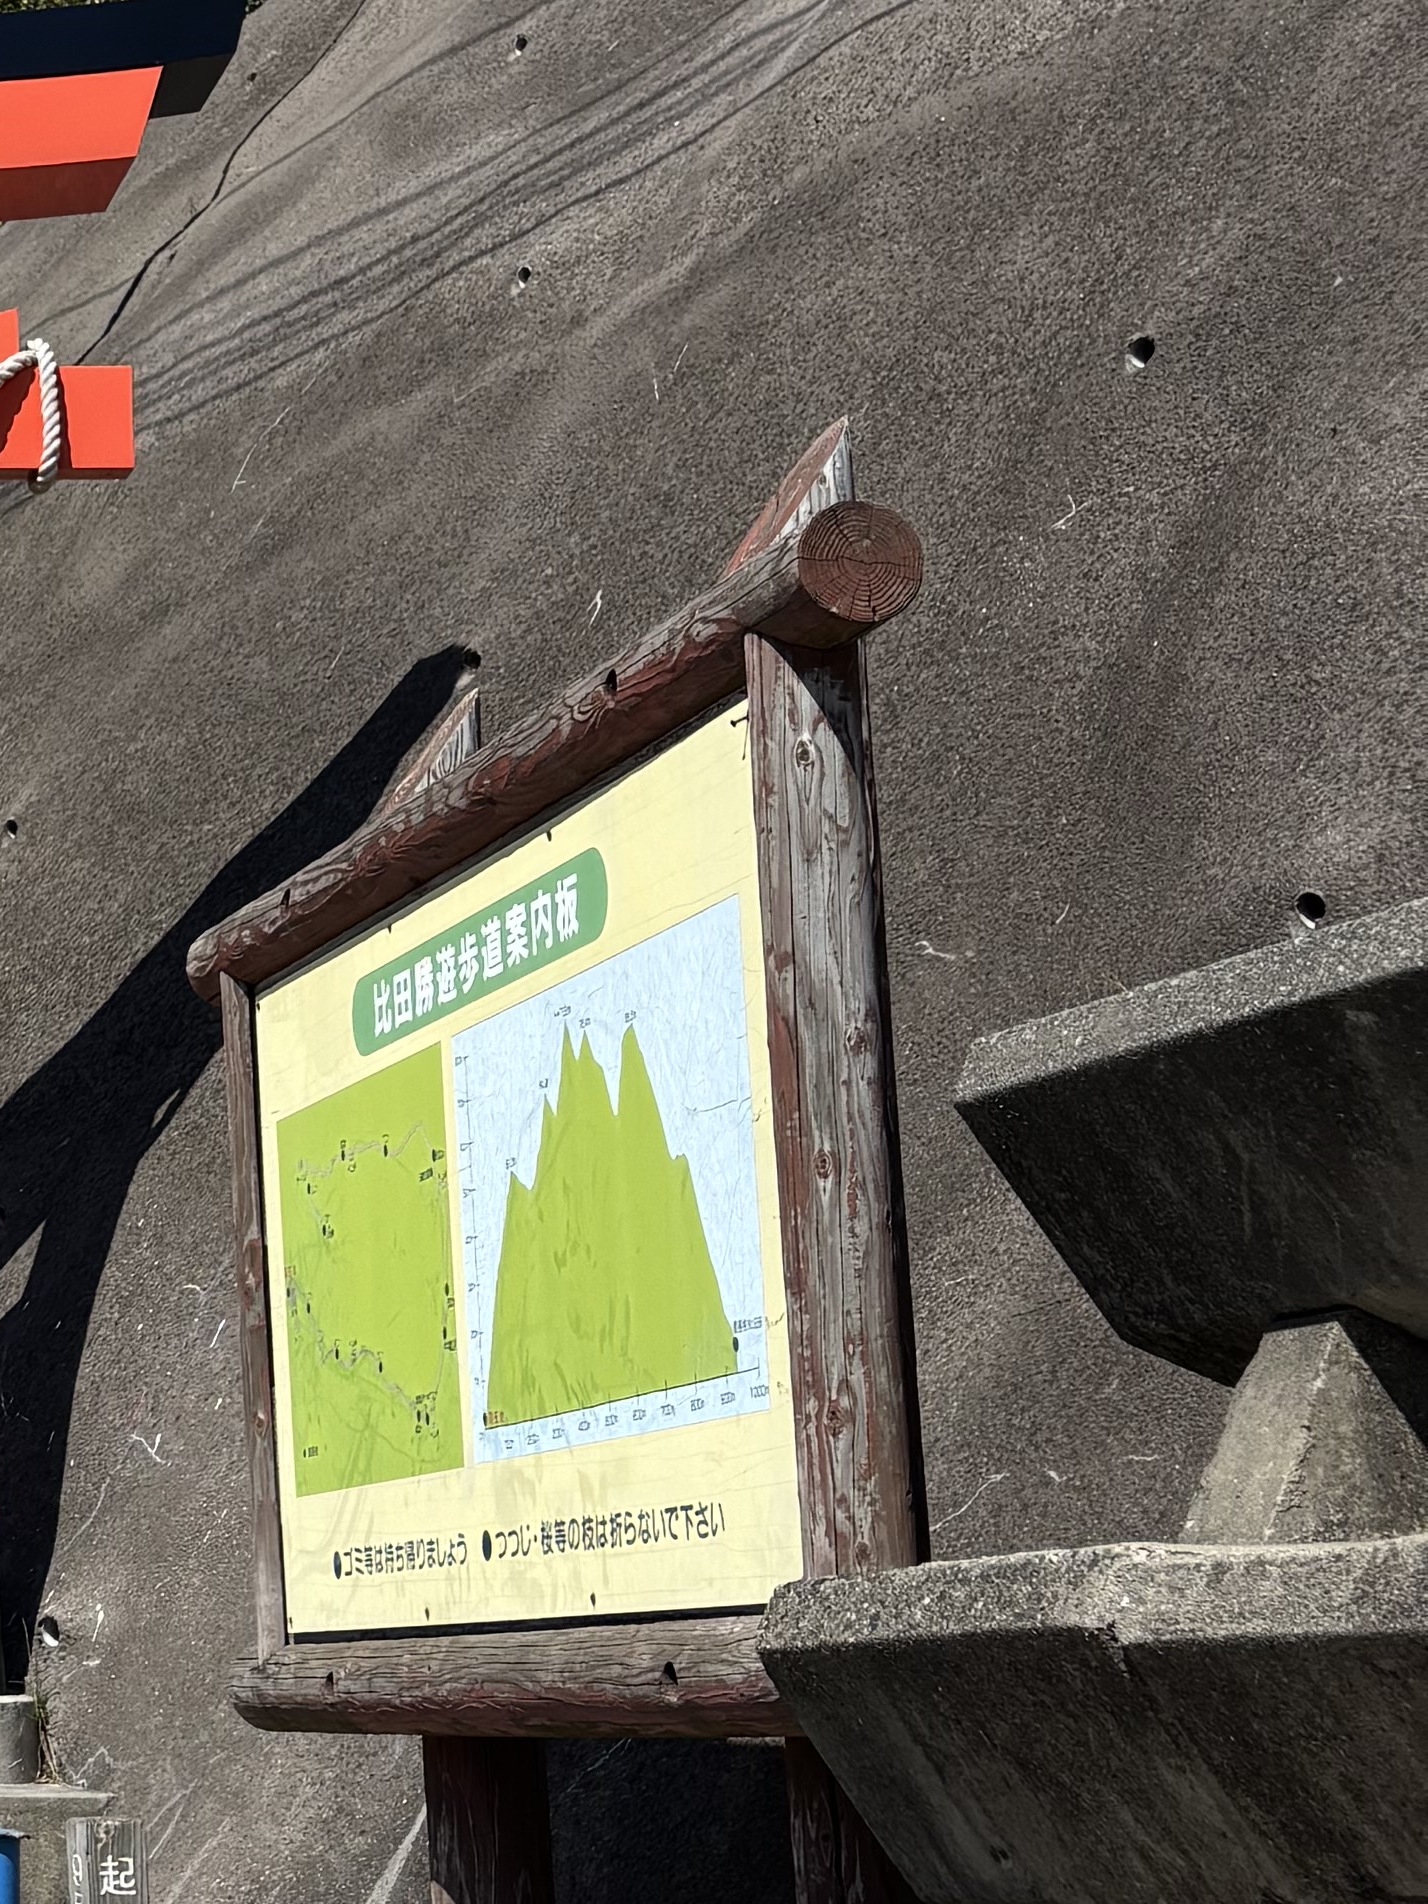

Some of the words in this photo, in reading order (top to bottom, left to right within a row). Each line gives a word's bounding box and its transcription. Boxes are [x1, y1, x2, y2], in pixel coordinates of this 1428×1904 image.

[373, 873, 579, 1038] 比田勝遊歩道案内板
